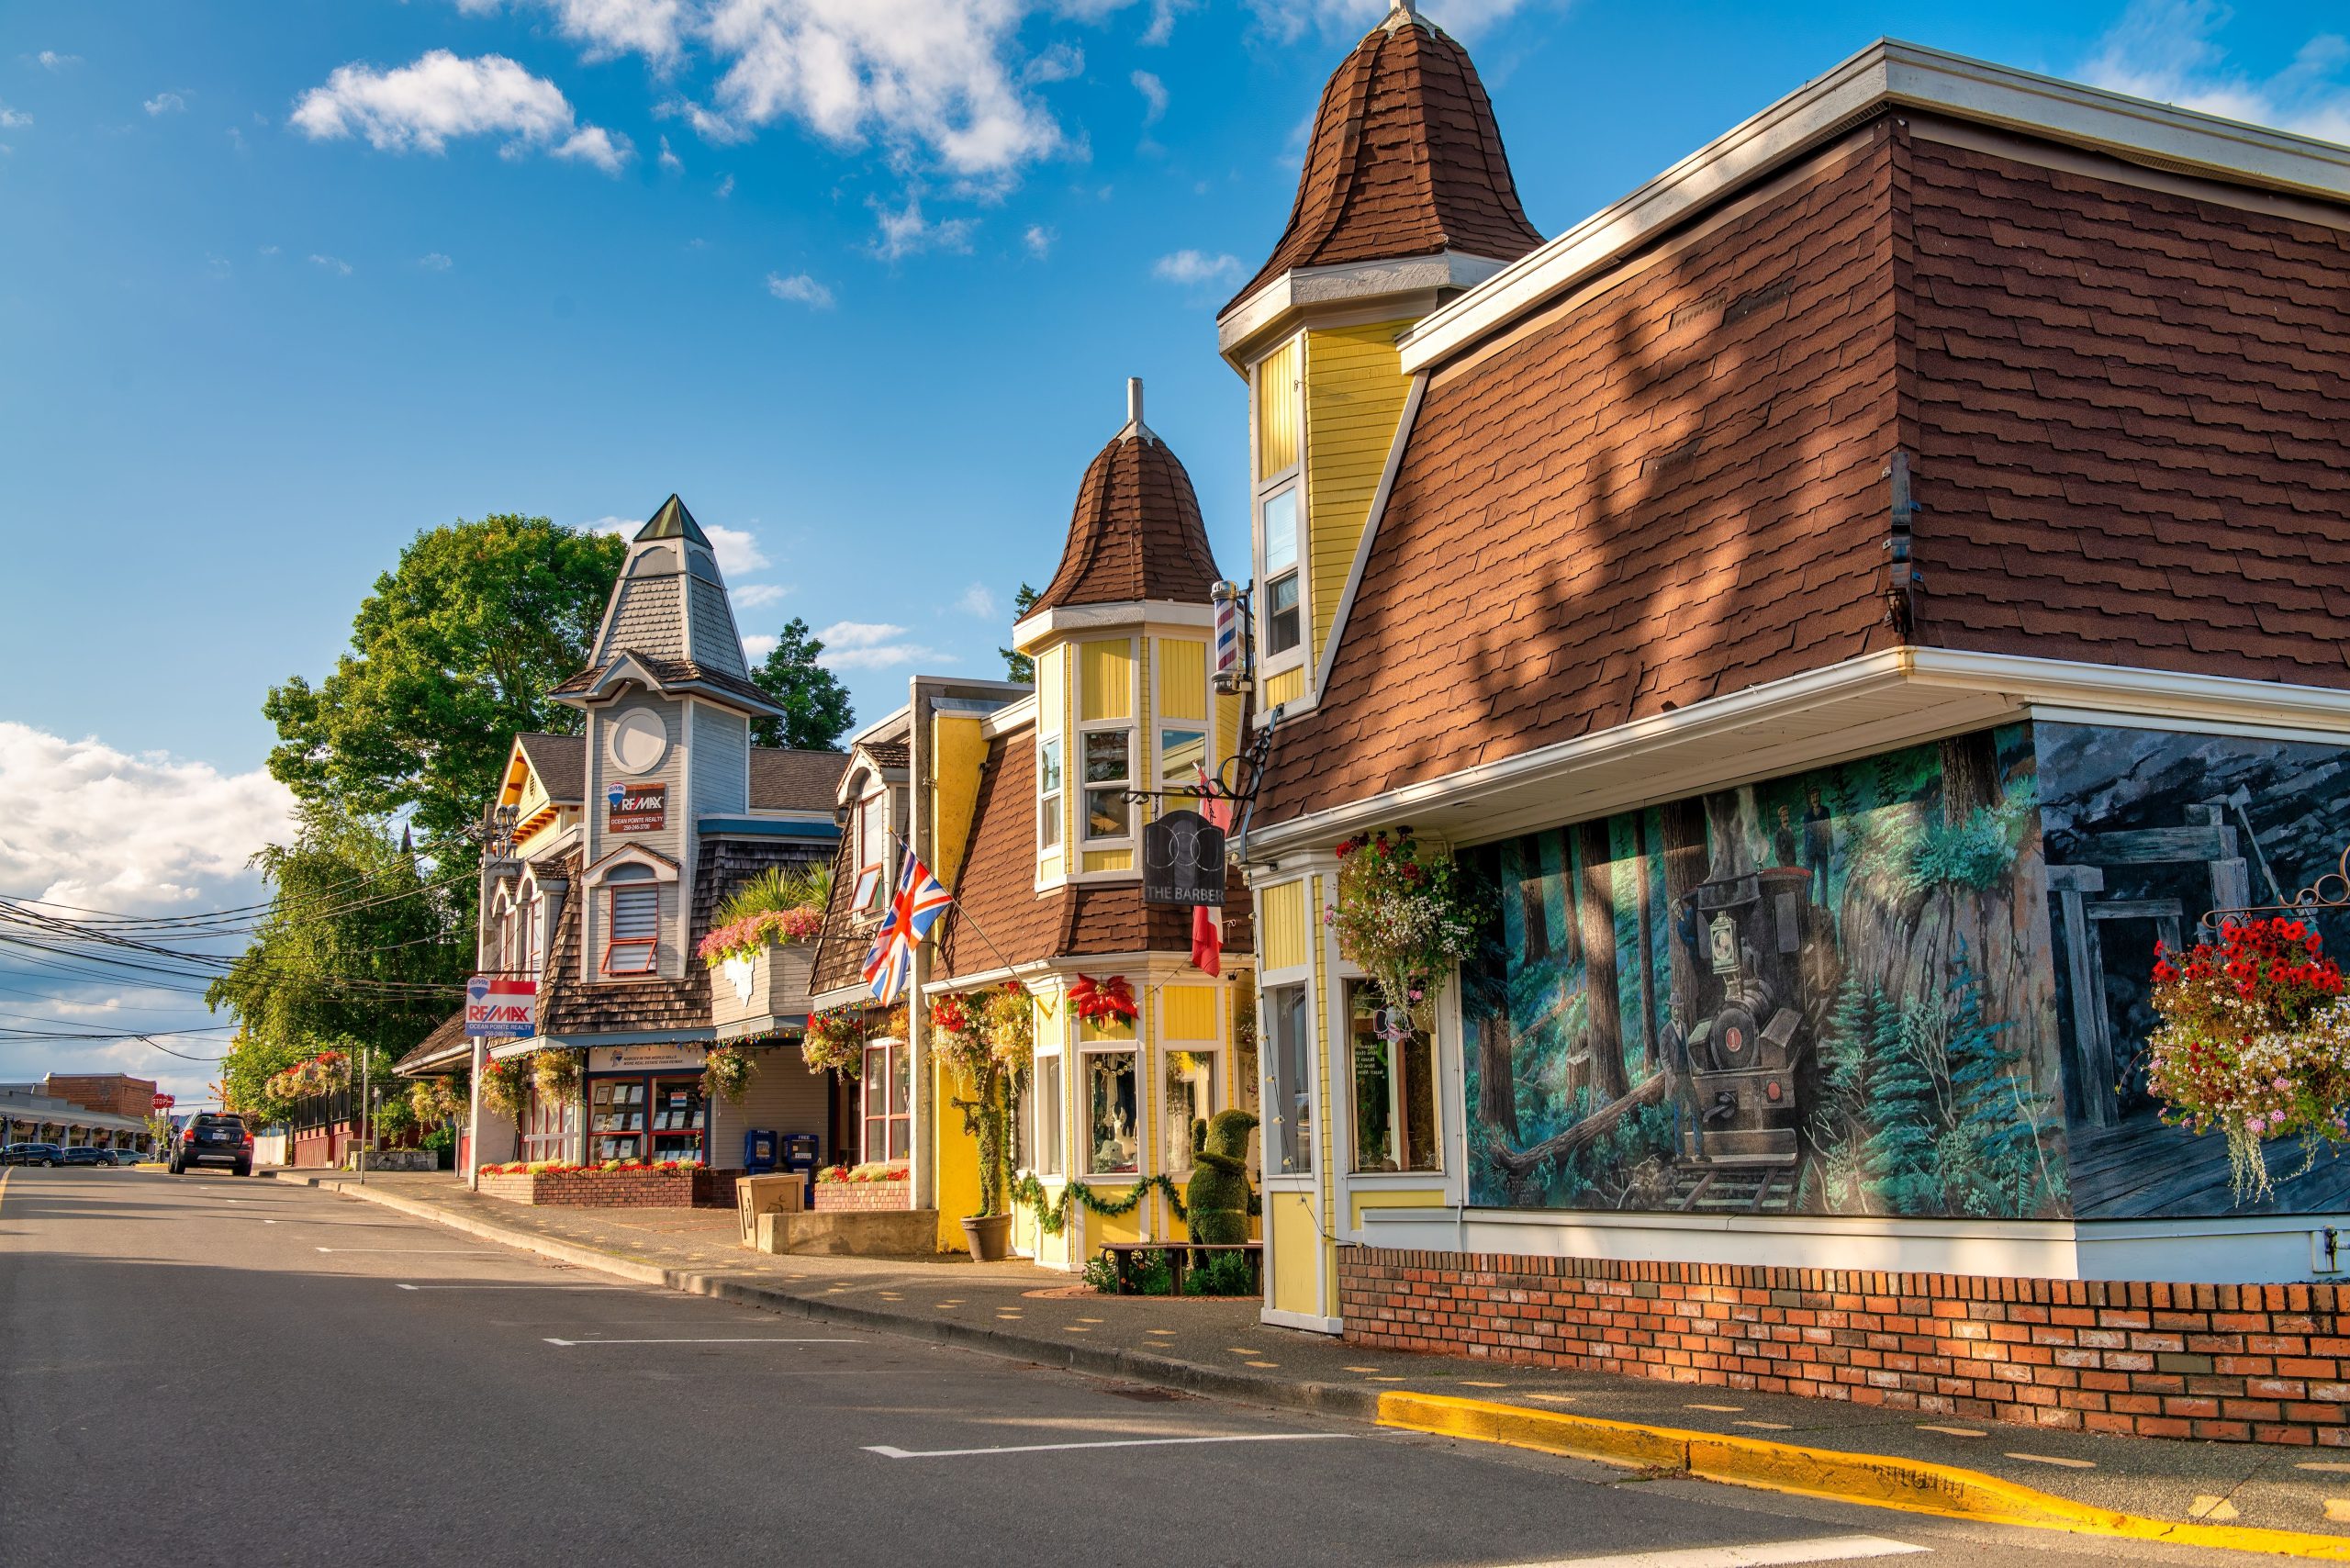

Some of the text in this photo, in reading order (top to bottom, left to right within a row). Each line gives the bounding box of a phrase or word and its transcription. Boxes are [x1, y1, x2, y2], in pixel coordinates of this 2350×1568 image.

[621, 795, 662, 811] RE/MAX
[1147, 885, 1225, 902] THE BARBER
[469, 1005, 530, 1022] RE/MAX
